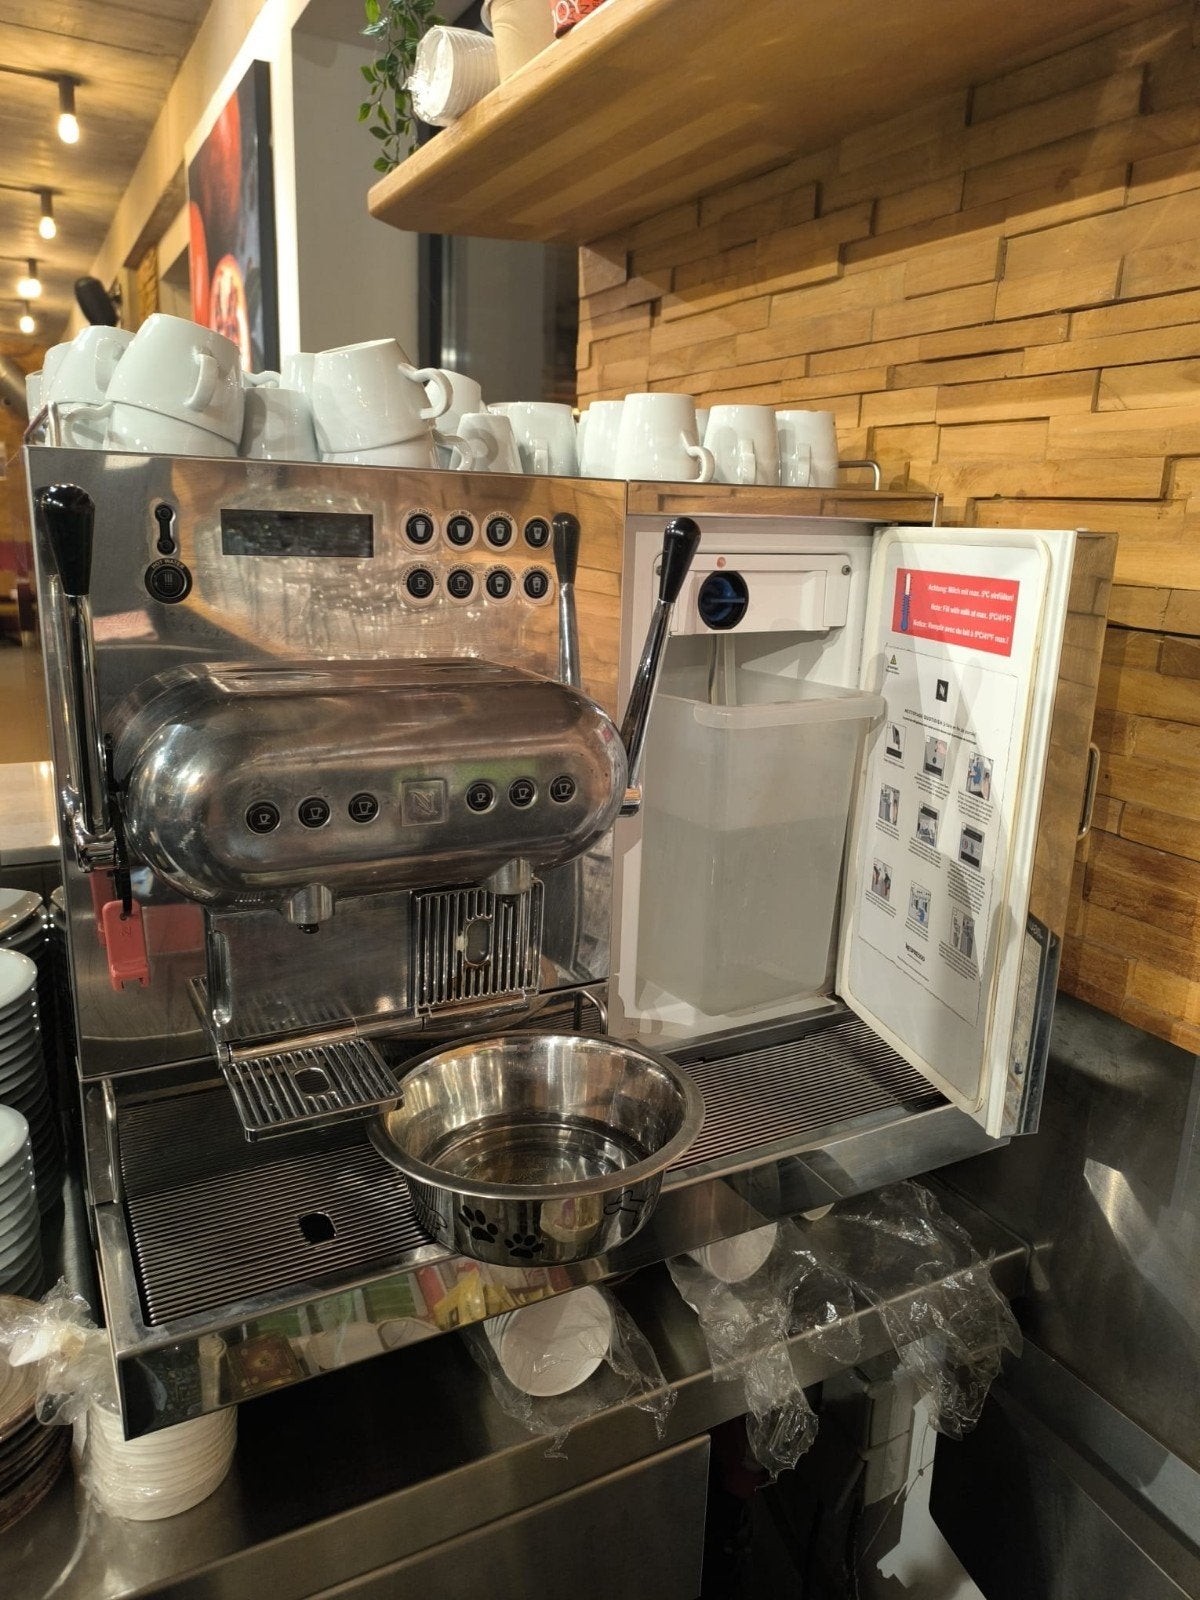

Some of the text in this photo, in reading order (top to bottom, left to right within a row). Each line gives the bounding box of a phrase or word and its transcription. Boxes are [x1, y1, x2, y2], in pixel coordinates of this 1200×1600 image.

[151, 559, 185, 569] HOT WATER
[928, 584, 948, 595] Achtung:
[948, 586, 960, 595] Milch
[960, 588, 969, 596] mit
[969, 589, 980, 597] max.
[980, 590, 990, 598] 5°C
[942, 605, 950, 613] Fill
[950, 606, 960, 614] with
[960, 608, 970, 616] milk
[976, 611, 988, 619] max.
[944, 625, 955, 633] avec
[955, 627, 962, 635] du
